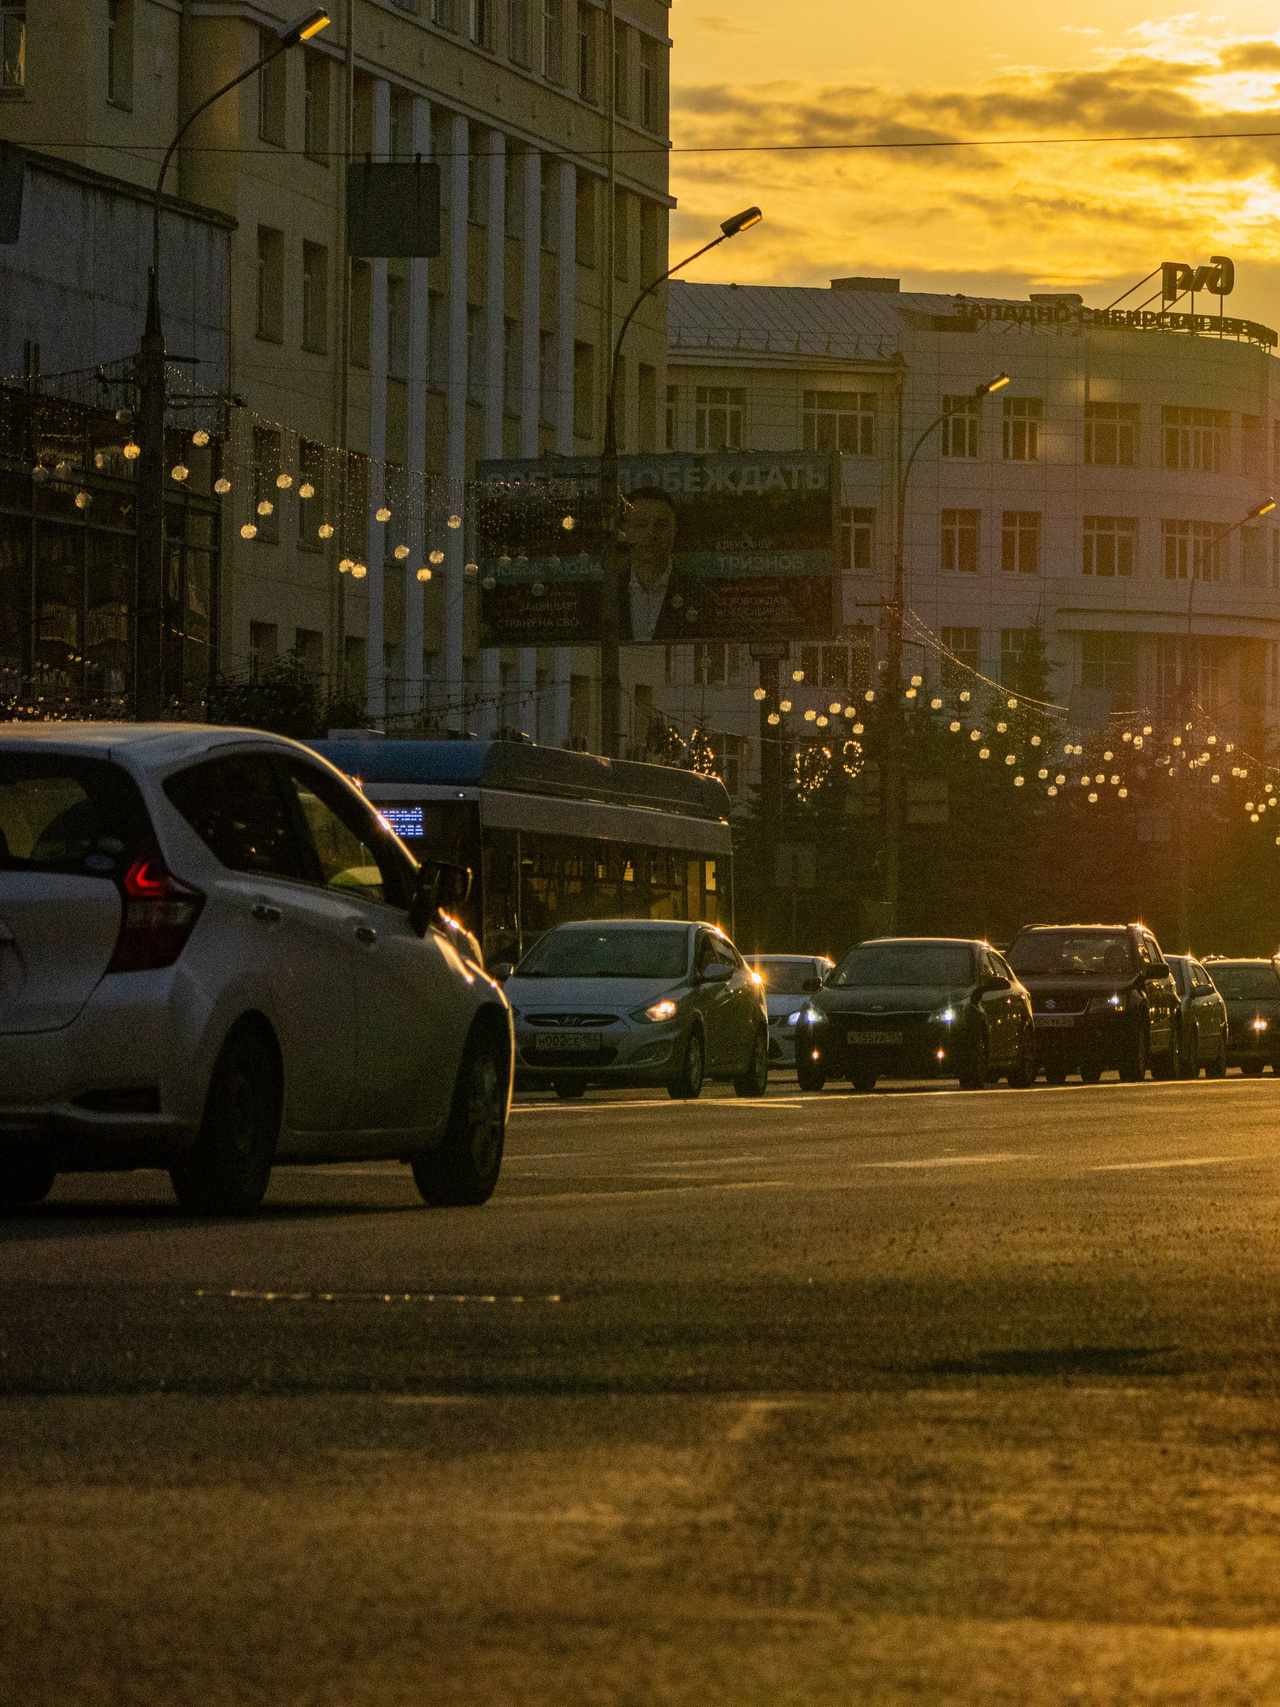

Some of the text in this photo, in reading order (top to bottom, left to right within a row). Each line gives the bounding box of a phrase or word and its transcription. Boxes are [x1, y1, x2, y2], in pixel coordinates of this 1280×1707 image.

[617, 463, 826, 496] ПОБЕЖДАТЬ
[539, 618, 554, 627] НА
[556, 617, 580, 627] СВО
